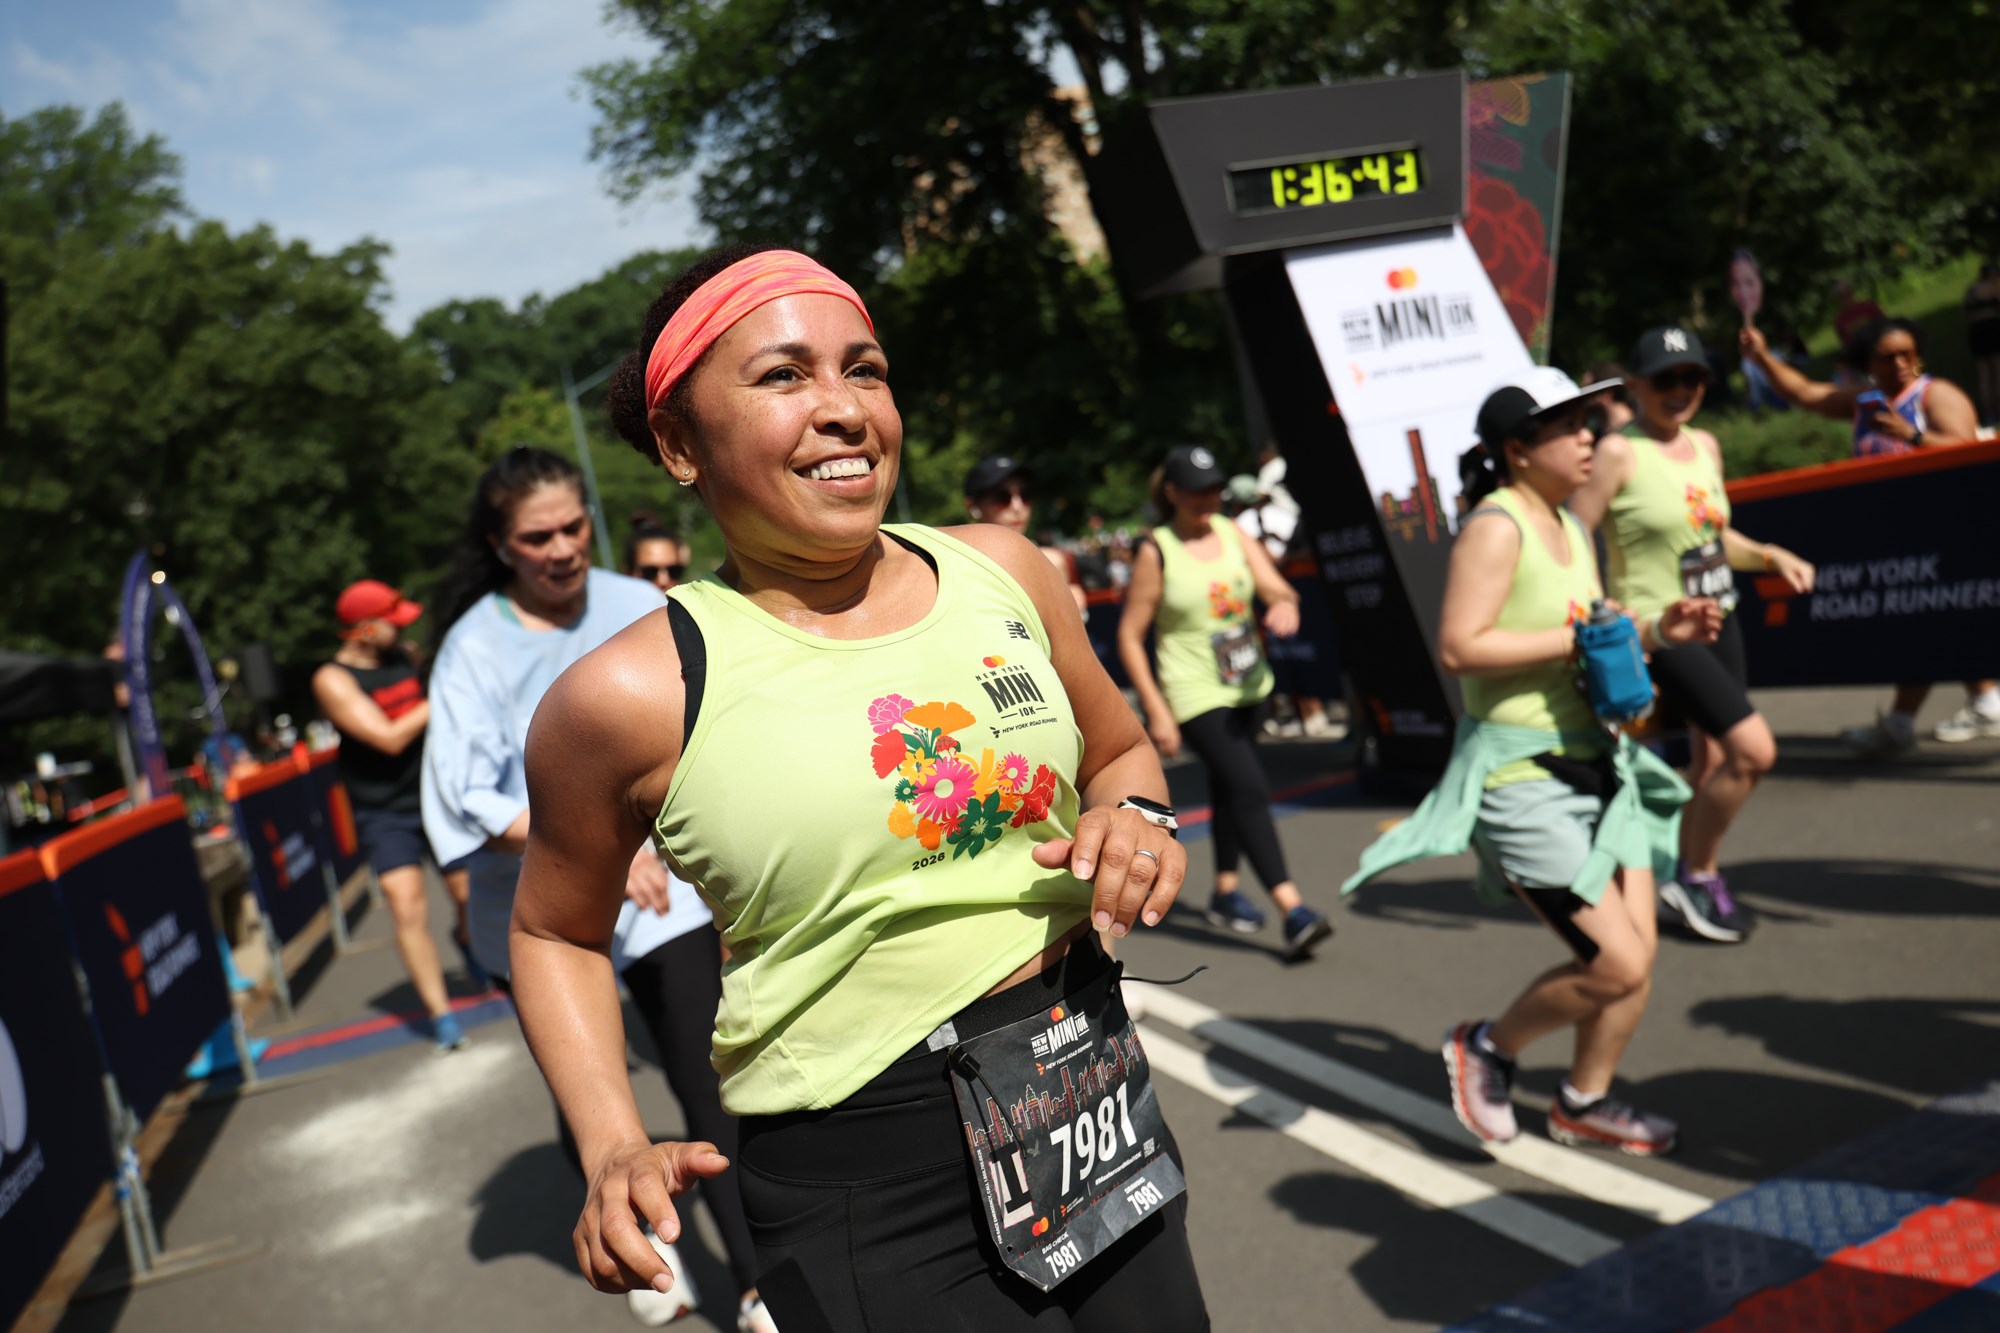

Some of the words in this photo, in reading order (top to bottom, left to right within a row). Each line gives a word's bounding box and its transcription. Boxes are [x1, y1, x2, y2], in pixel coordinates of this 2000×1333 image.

[1375, 295, 1445, 350] MINI
[1866, 554, 1939, 587] YORK
[1810, 590, 1876, 620] ROAD
[975, 670, 997, 681] NEW
[1001, 664, 1026, 674] YORK
[981, 672, 1045, 713] MINI
[1019, 706, 1036, 717] 10K
[1002, 726, 1015, 734] NEW
[1015, 722, 1029, 730] YORK
[1029, 719, 1041, 727] ROAD
[912, 852, 945, 871] 2026
[1031, 1036, 1047, 1048] NEW
[1047, 1015, 1078, 1054] MINI
[1075, 1014, 1089, 1034] 10K
[1032, 1043, 1049, 1055] YORK
[1046, 1061, 1056, 1070] NEW
[1056, 1055, 1067, 1065] YORK
[1067, 1050, 1078, 1060] ROAD
[1050, 1081, 1137, 1196] 7981
[1127, 1181, 1164, 1215] 7981
[1041, 1243, 1052, 1255] BAG
[1052, 1231, 1069, 1247] CHECK
[1045, 1240, 1082, 1279] 7981
